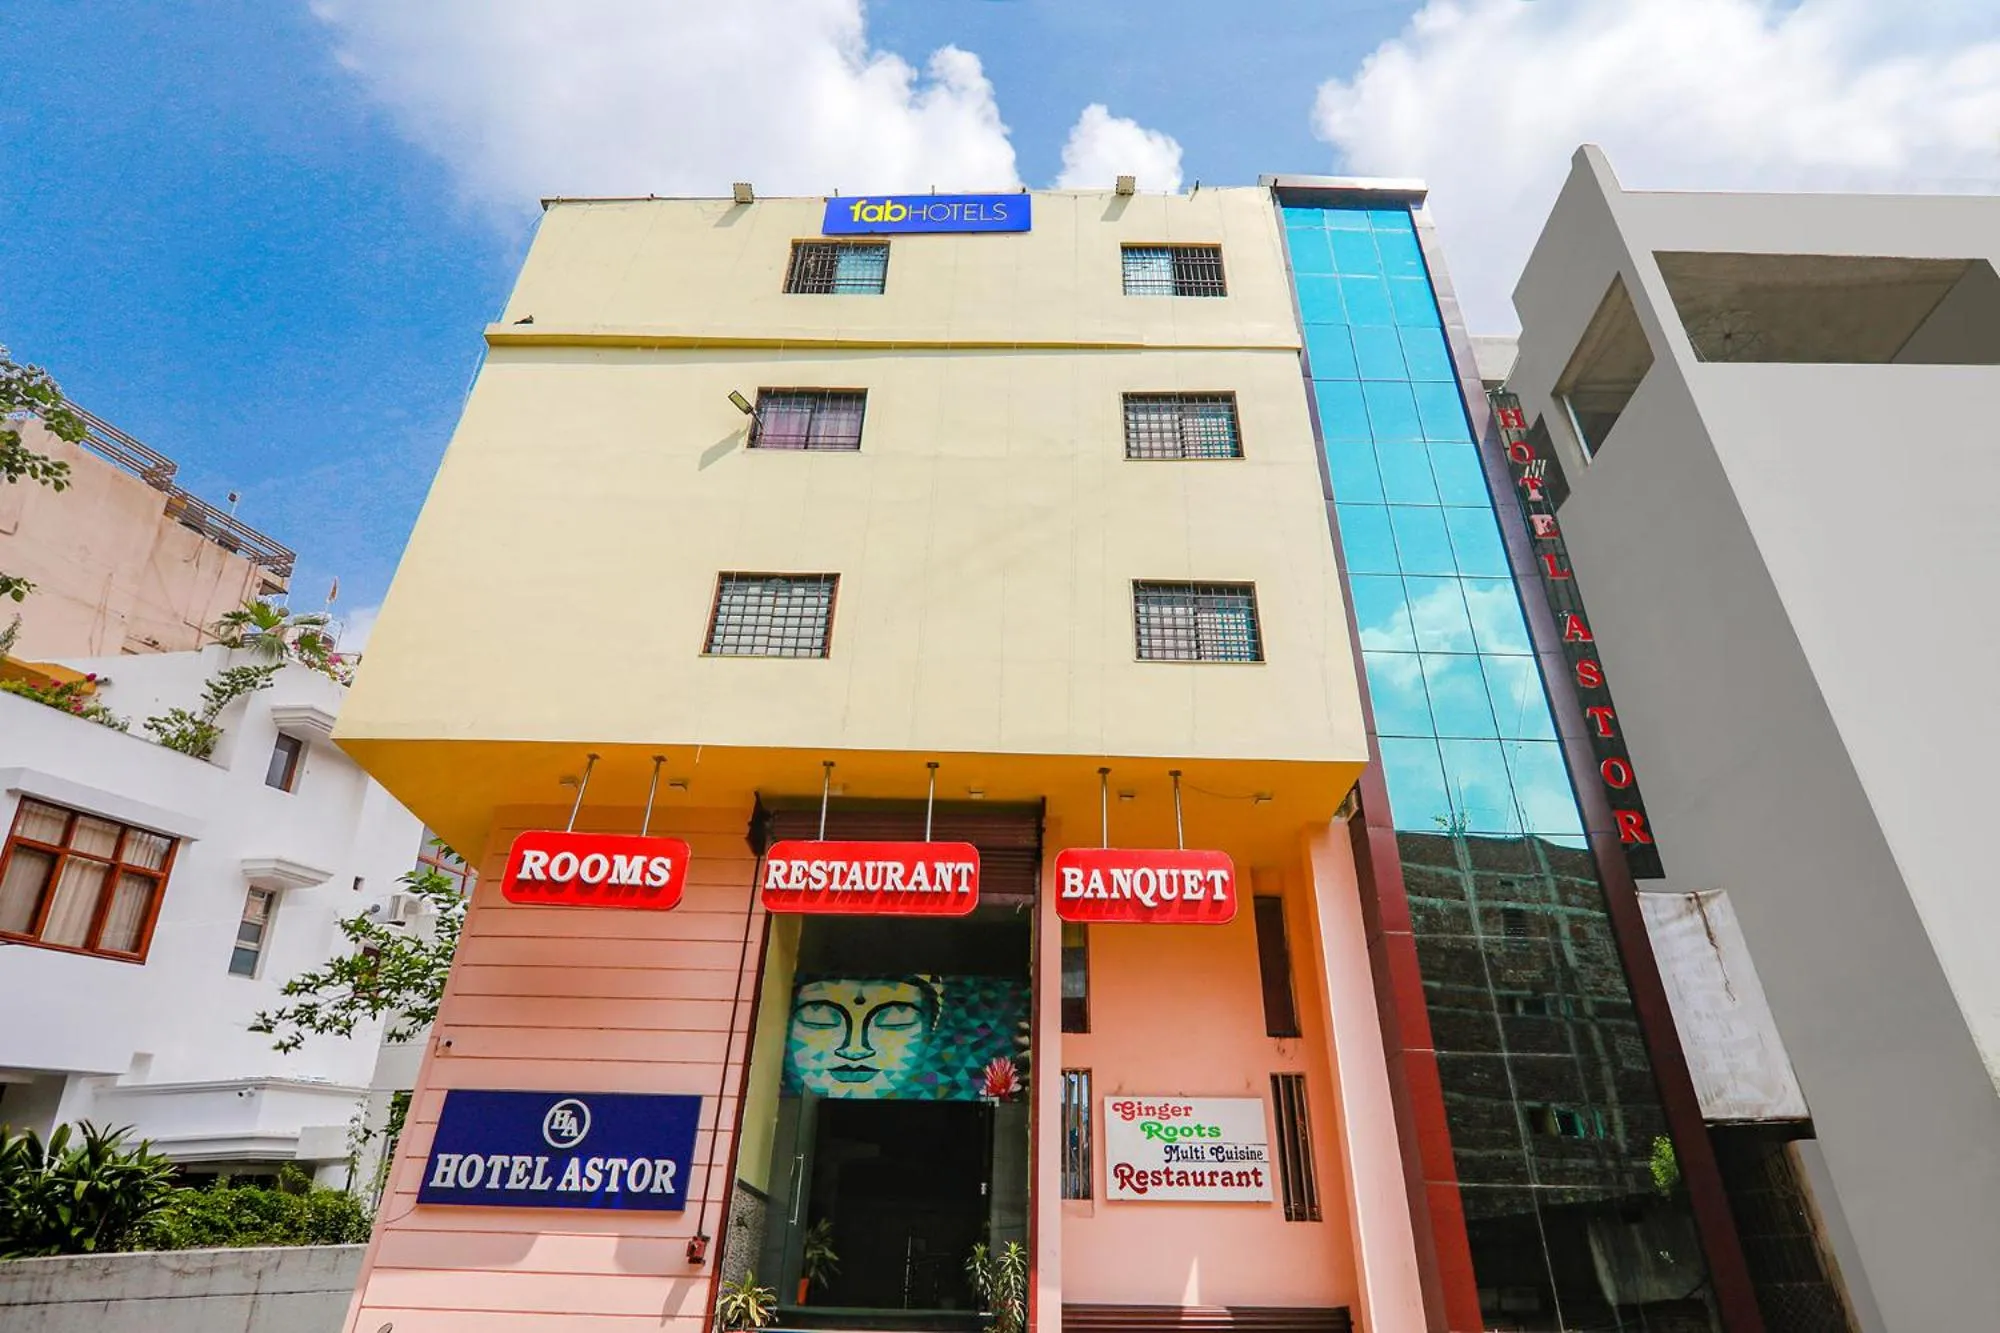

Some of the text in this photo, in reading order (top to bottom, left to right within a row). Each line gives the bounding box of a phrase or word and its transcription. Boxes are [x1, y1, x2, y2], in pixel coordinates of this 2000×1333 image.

[1496, 407, 1653, 844] HOTEL ASTOR
[517, 849, 672, 888] ROOMS
[765, 859, 974, 893] RESTAURANT
[1061, 867, 1230, 907] BANQUET
[1111, 1100, 1193, 1121] Ginger
[1140, 1121, 1221, 1143] Roots
[1163, 1144, 1264, 1164] Multi Cuisine
[429, 1153, 677, 1194] HOTEL ASTOR
[1112, 1162, 1264, 1195] Restaurant
